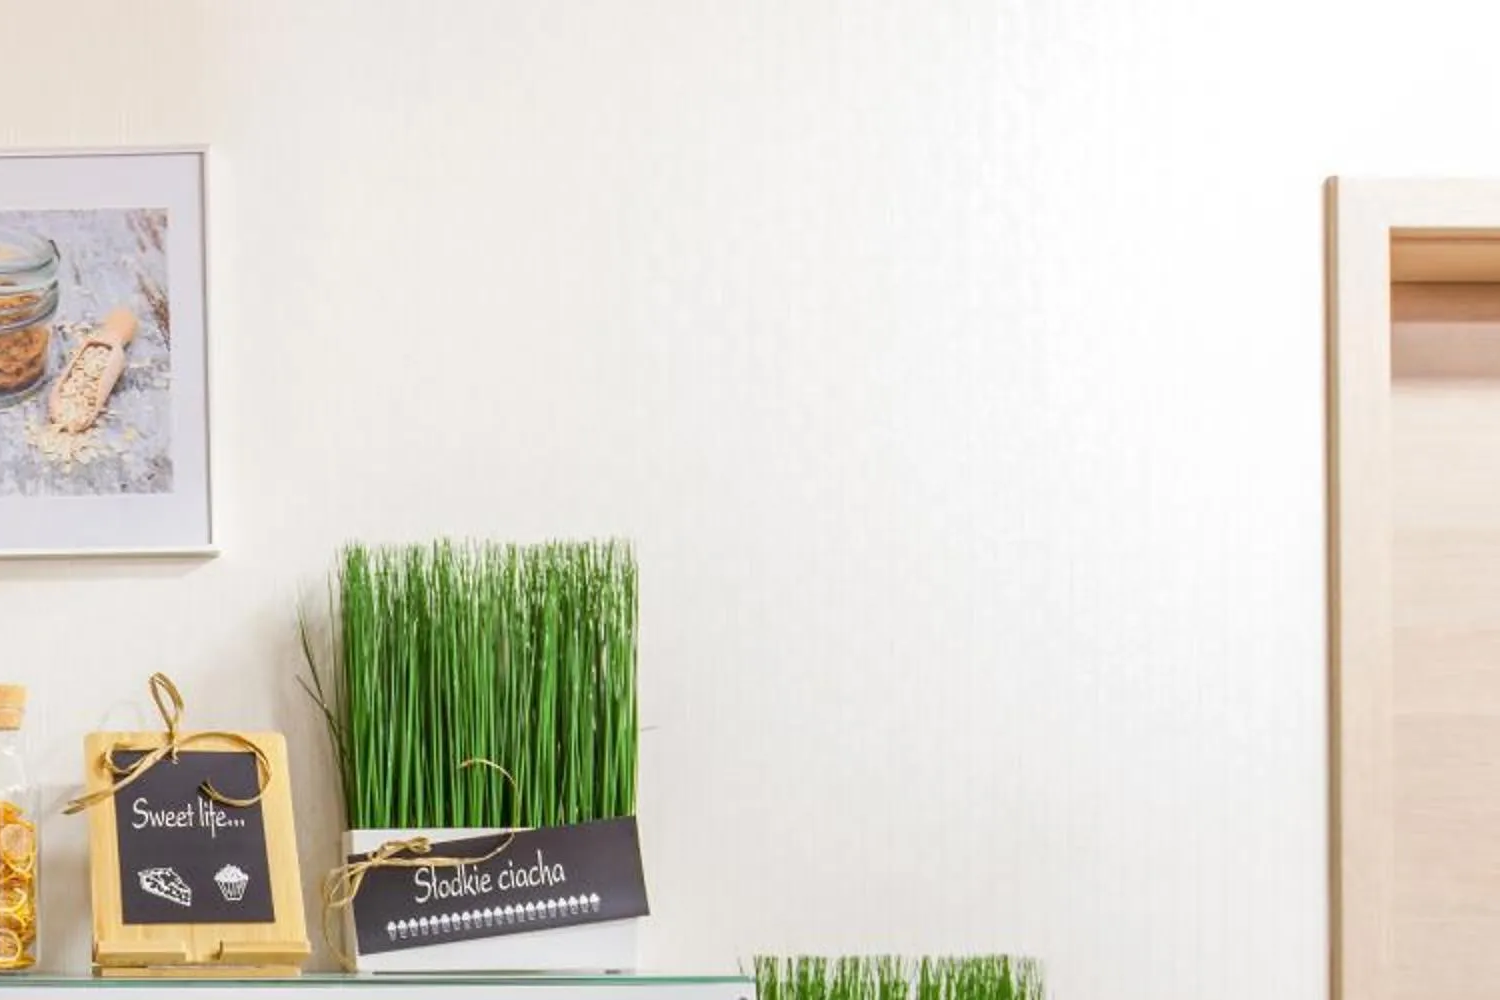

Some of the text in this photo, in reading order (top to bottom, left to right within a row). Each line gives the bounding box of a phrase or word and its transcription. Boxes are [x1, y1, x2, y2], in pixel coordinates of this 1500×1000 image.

[131, 797, 195, 829] Sweet
[414, 849, 566, 903] Słodkie ciacha
